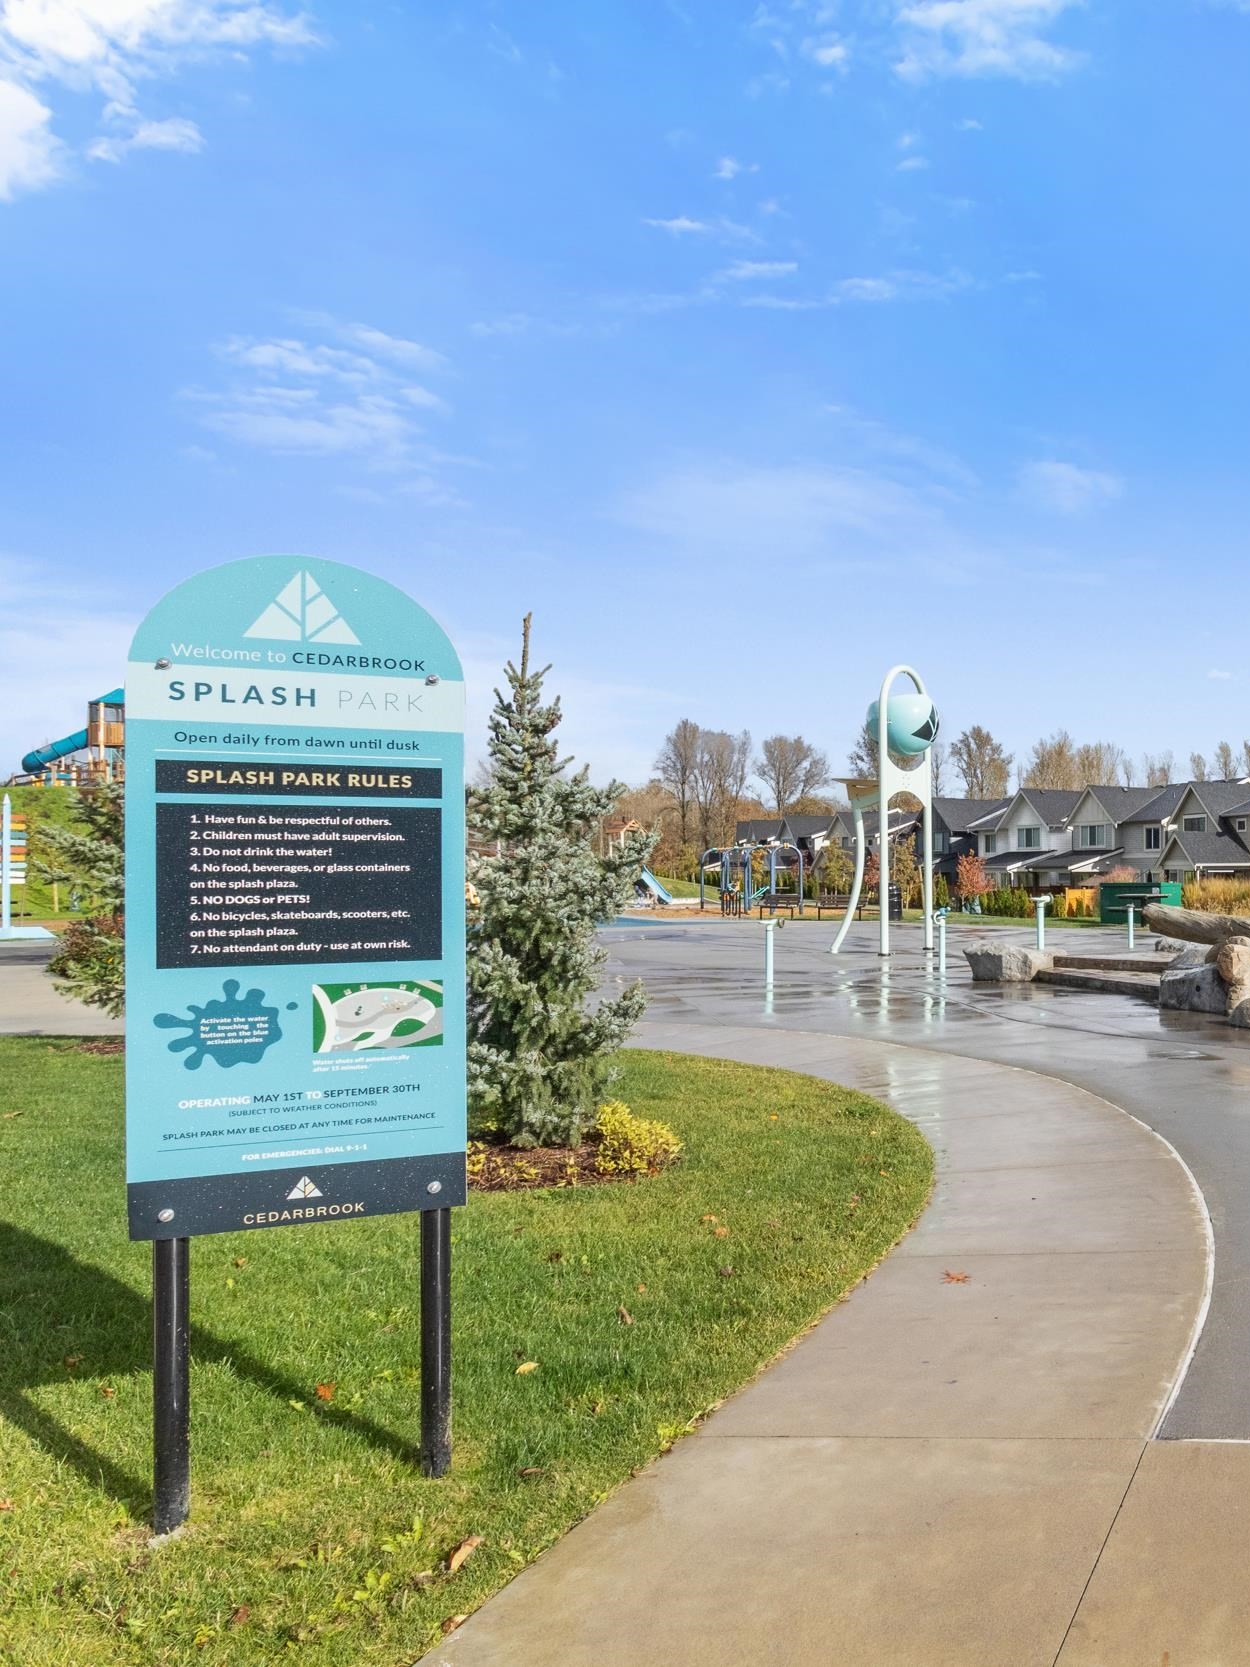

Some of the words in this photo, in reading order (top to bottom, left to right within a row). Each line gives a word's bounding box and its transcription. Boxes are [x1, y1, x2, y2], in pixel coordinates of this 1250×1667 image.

[171, 642, 262, 662] Welcome
[267, 650, 287, 663] to
[292, 652, 425, 671] CEDARBROOK
[168, 681, 316, 708] SPLASH
[338, 690, 424, 712] PARK
[174, 731, 218, 744] Open
[222, 733, 260, 747] daily
[263, 735, 300, 746] from
[305, 737, 345, 748] dawn
[350, 739, 382, 749] until
[386, 740, 420, 751] dusk
[186, 769, 275, 785] SPLASH
[282, 772, 341, 786] PARK
[348, 774, 412, 788] RULES
[190, 814, 202, 824] 1.
[205, 815, 235, 824] Have
[236, 815, 256, 824] fun
[257, 815, 267, 824] &
[269, 815, 283, 825] be
[285, 816, 340, 826] respectful
[341, 817, 354, 825] of
[355, 817, 392, 826] others.
[189, 831, 201, 840] 2.
[203, 831, 252, 840] Children
[254, 832, 282, 840] must
[284, 832, 310, 840] have
[312, 832, 340, 841] adult
[342, 832, 406, 842] supervision.
[189, 847, 201, 856] 3.
[203, 847, 220, 856] Do
[222, 848, 242, 856] not
[243, 847, 274, 856] drink
[275, 847, 294, 856] the
[296, 848, 333, 856] water!
[189, 864, 201, 872] 4.
[203, 864, 220, 872] No
[221, 863, 251, 873] food,
[253, 863, 312, 873] beverages,
[326, 863, 354, 873] glass
[355, 863, 411, 872] containers
[207, 880, 227, 888] the
[228, 879, 264, 889] splash
[266, 879, 299, 890] plaza.
[190, 896, 201, 905] 5.
[203, 896, 223, 905] NO
[225, 895, 261, 904] DOGS
[277, 894, 310, 904] PETS!
[190, 912, 201, 921] 6.
[203, 912, 220, 921] No
[222, 911, 270, 922] bicycles,
[271, 910, 341, 920] skateboards,
[342, 910, 390, 919] scooters,
[391, 910, 411, 918] etc.
[189, 930, 205, 938] on
[207, 928, 227, 937] the
[228, 927, 264, 938] splash
[266, 927, 299, 937] plaza.
[190, 945, 201, 954] 7.
[203, 945, 221, 953] No
[222, 943, 278, 953] attendant
[296, 942, 322, 952] duty
[330, 942, 350, 950] use
[350, 941, 363, 949] at
[388, 940, 411, 948] risk.
[178, 1095, 251, 1109] OPERATING
[253, 1093, 280, 1104] MAY
[283, 1091, 303, 1102] 1ST
[305, 1090, 321, 1100] TO
[323, 1085, 390, 1099] SEPTEMBER
[392, 1083, 421, 1093] 30TH
[228, 1108, 267, 1118] (SUBJECT
[282, 1102, 322, 1113] WEATHER
[324, 1099, 378, 1110] CONDITIONS)
[162, 1131, 198, 1141] SPLASH
[200, 1129, 225, 1138] PARK
[226, 1127, 247, 1136] MAY
[249, 1126, 260, 1134] BE
[262, 1123, 297, 1133] CLOSED
[298, 1122, 310, 1130] AT
[312, 1120, 331, 1129] ANY
[332, 1118, 354, 1127] TIME
[355, 1117, 373, 1125] FOR
[374, 1112, 436, 1123] MAINTENANCE
[241, 1153, 261, 1161] FOR
[324, 1145, 345, 1154] DIAL
[243, 1202, 365, 1225] CEDARBROOK
